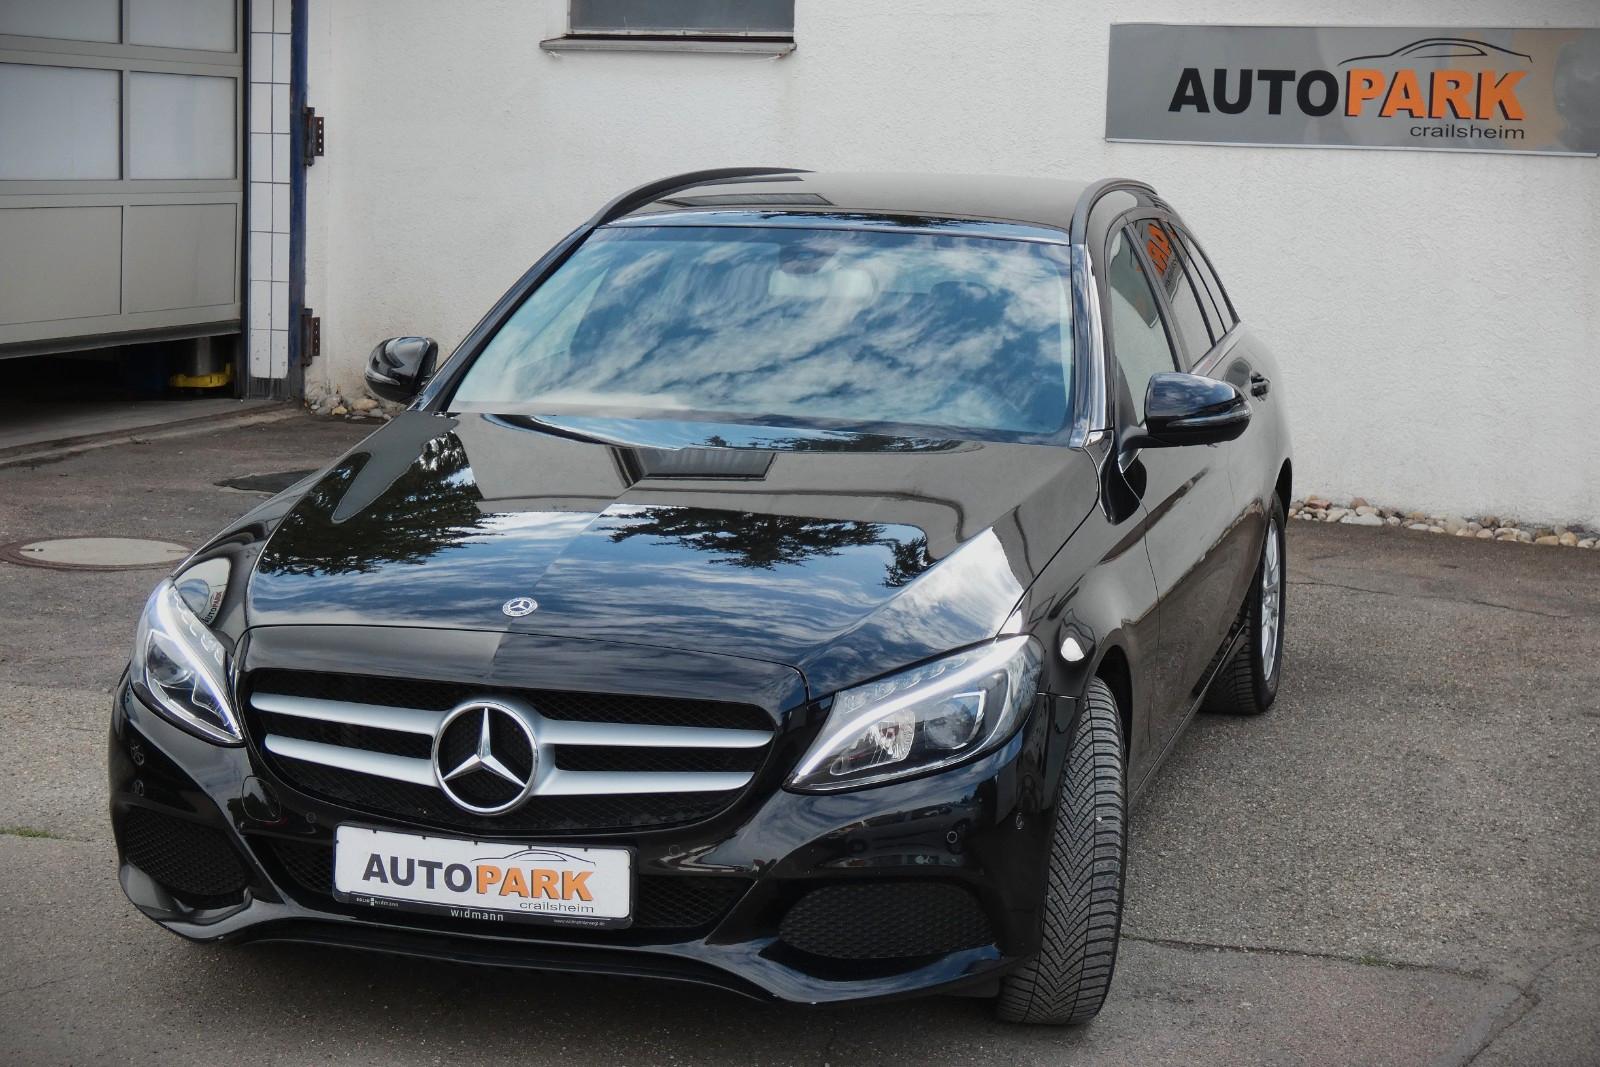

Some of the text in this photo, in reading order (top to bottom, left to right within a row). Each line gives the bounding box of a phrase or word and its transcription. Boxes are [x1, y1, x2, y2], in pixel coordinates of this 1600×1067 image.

[1168, 67, 1530, 121] AUTOPARK
[1409, 123, 1525, 140] crailsheim
[361, 853, 594, 902] AUTOPARK
[450, 907, 505, 922] widmann
[519, 901, 595, 914] crailsheim
